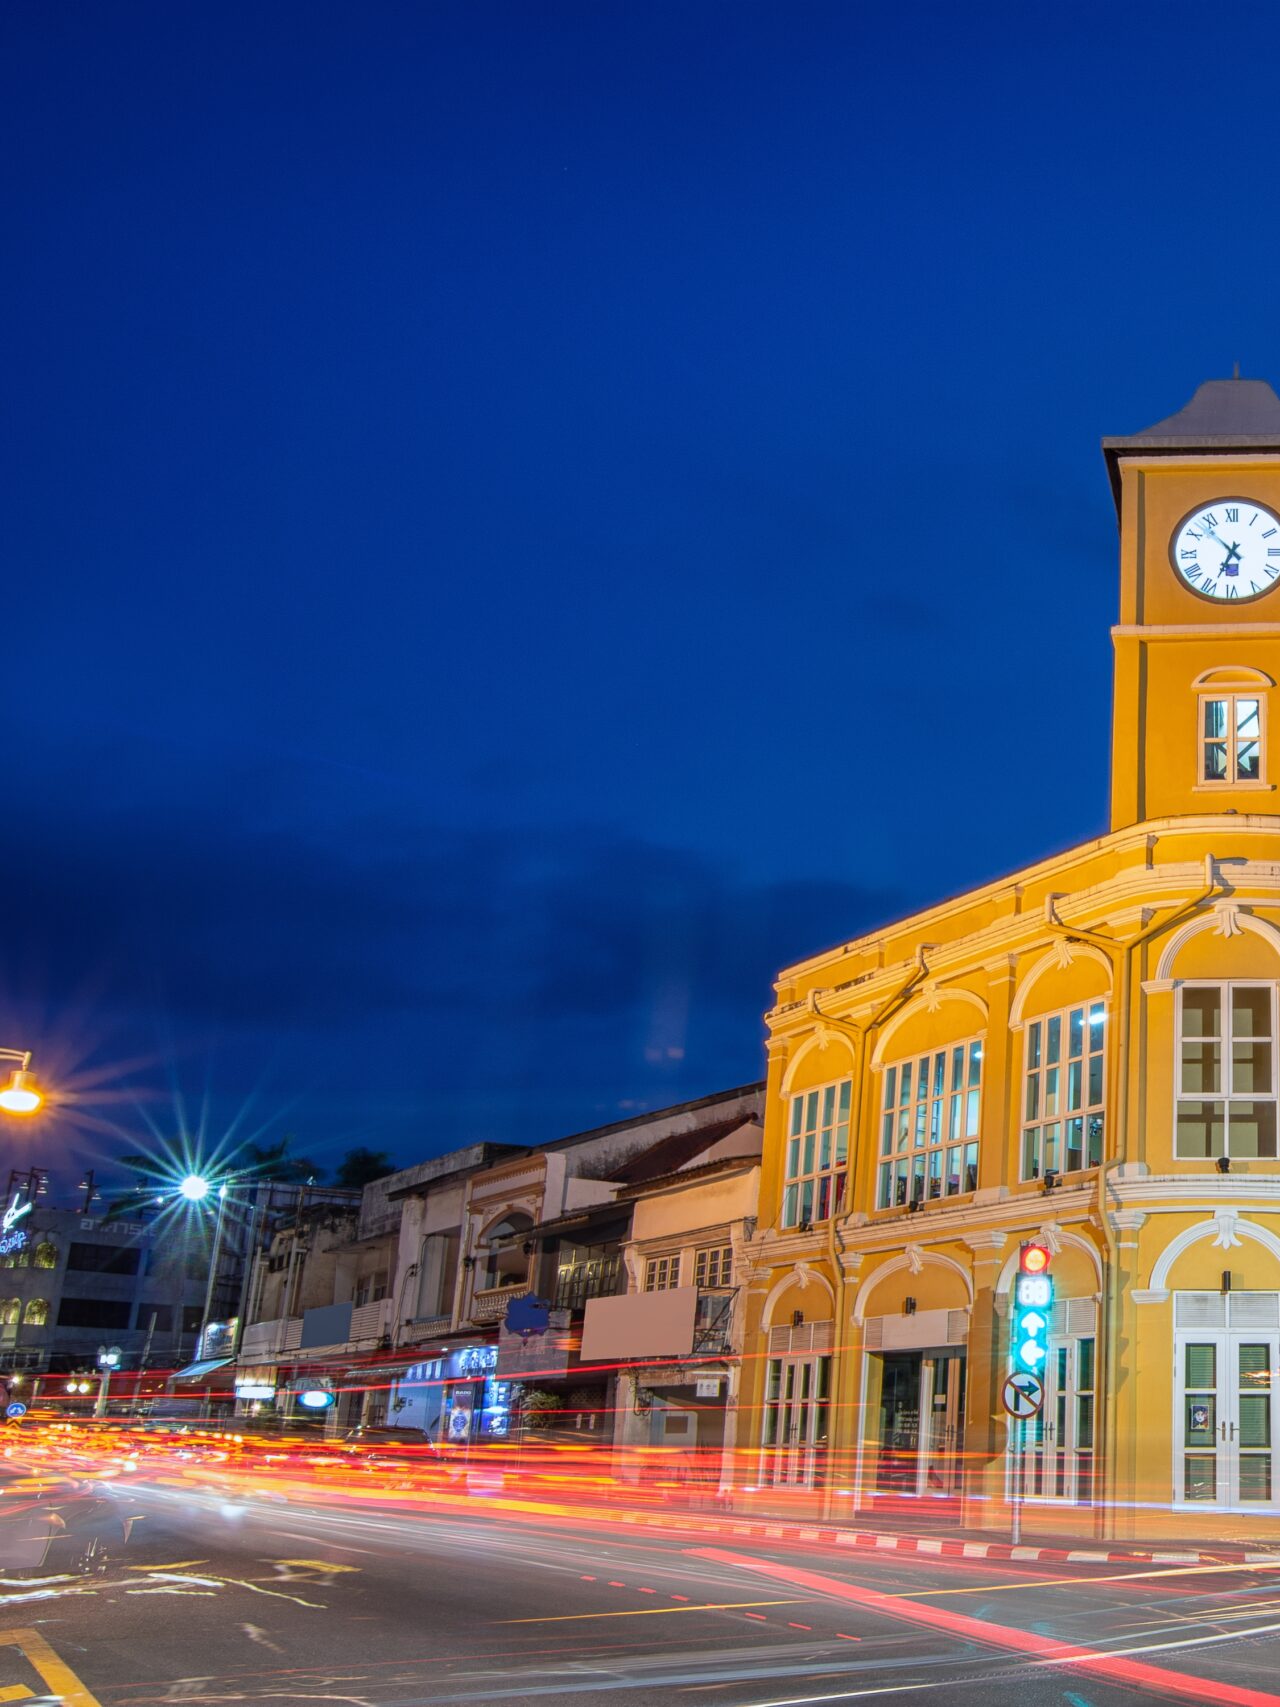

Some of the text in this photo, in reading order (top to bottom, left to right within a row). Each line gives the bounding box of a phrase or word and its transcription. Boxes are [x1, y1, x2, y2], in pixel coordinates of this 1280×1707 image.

[1202, 512, 1218, 529] XI
[1225, 508, 1239, 523] XII
[1249, 513, 1258, 526] I
[1186, 528, 1203, 541] X
[1261, 528, 1278, 539] II
[1181, 549, 1197, 559] IX
[1184, 563, 1203, 583] VIII
[1263, 563, 1280, 580] IV
[1201, 577, 1218, 595] VII
[1226, 584, 1239, 598] VI
[1250, 580, 1262, 594] V
